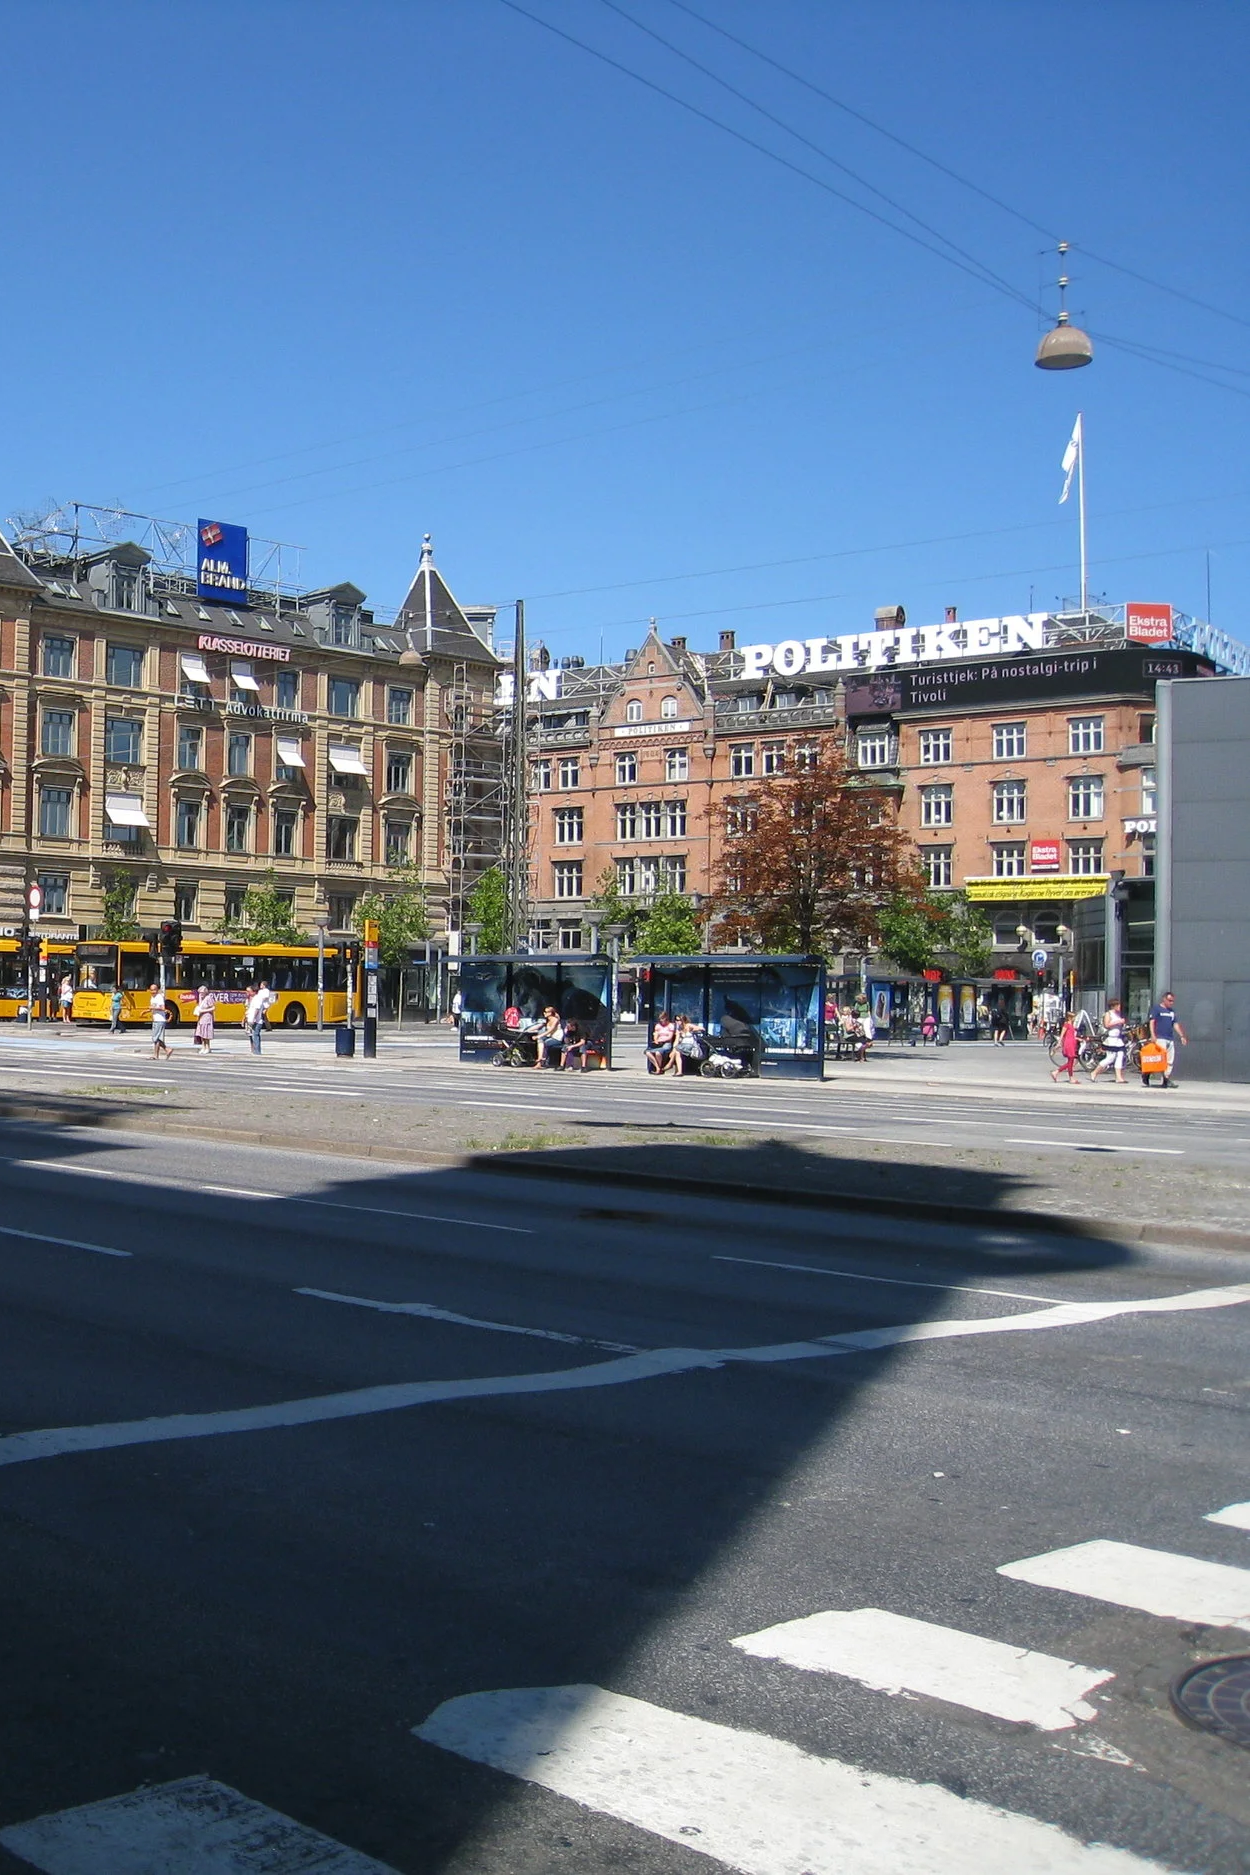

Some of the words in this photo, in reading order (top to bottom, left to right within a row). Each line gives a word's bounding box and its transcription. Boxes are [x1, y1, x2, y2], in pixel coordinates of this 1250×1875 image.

[201, 571, 247, 590] BRAND
[1129, 615, 1167, 627] Ekstra
[1129, 626, 1168, 637] Bladet
[198, 635, 290, 662] KLASSELOTTERIET
[741, 612, 1048, 679] POLITIKEN
[910, 669, 978, 686] Turisttjek:
[981, 665, 998, 680] På
[1002, 659, 1089, 677] nostalgi-trip
[1147, 663, 1179, 673] 14:43
[910, 689, 946, 703] Tivoli
[226, 701, 309, 723] Advokatfirma
[628, 723, 676, 735] POLITIKEN
